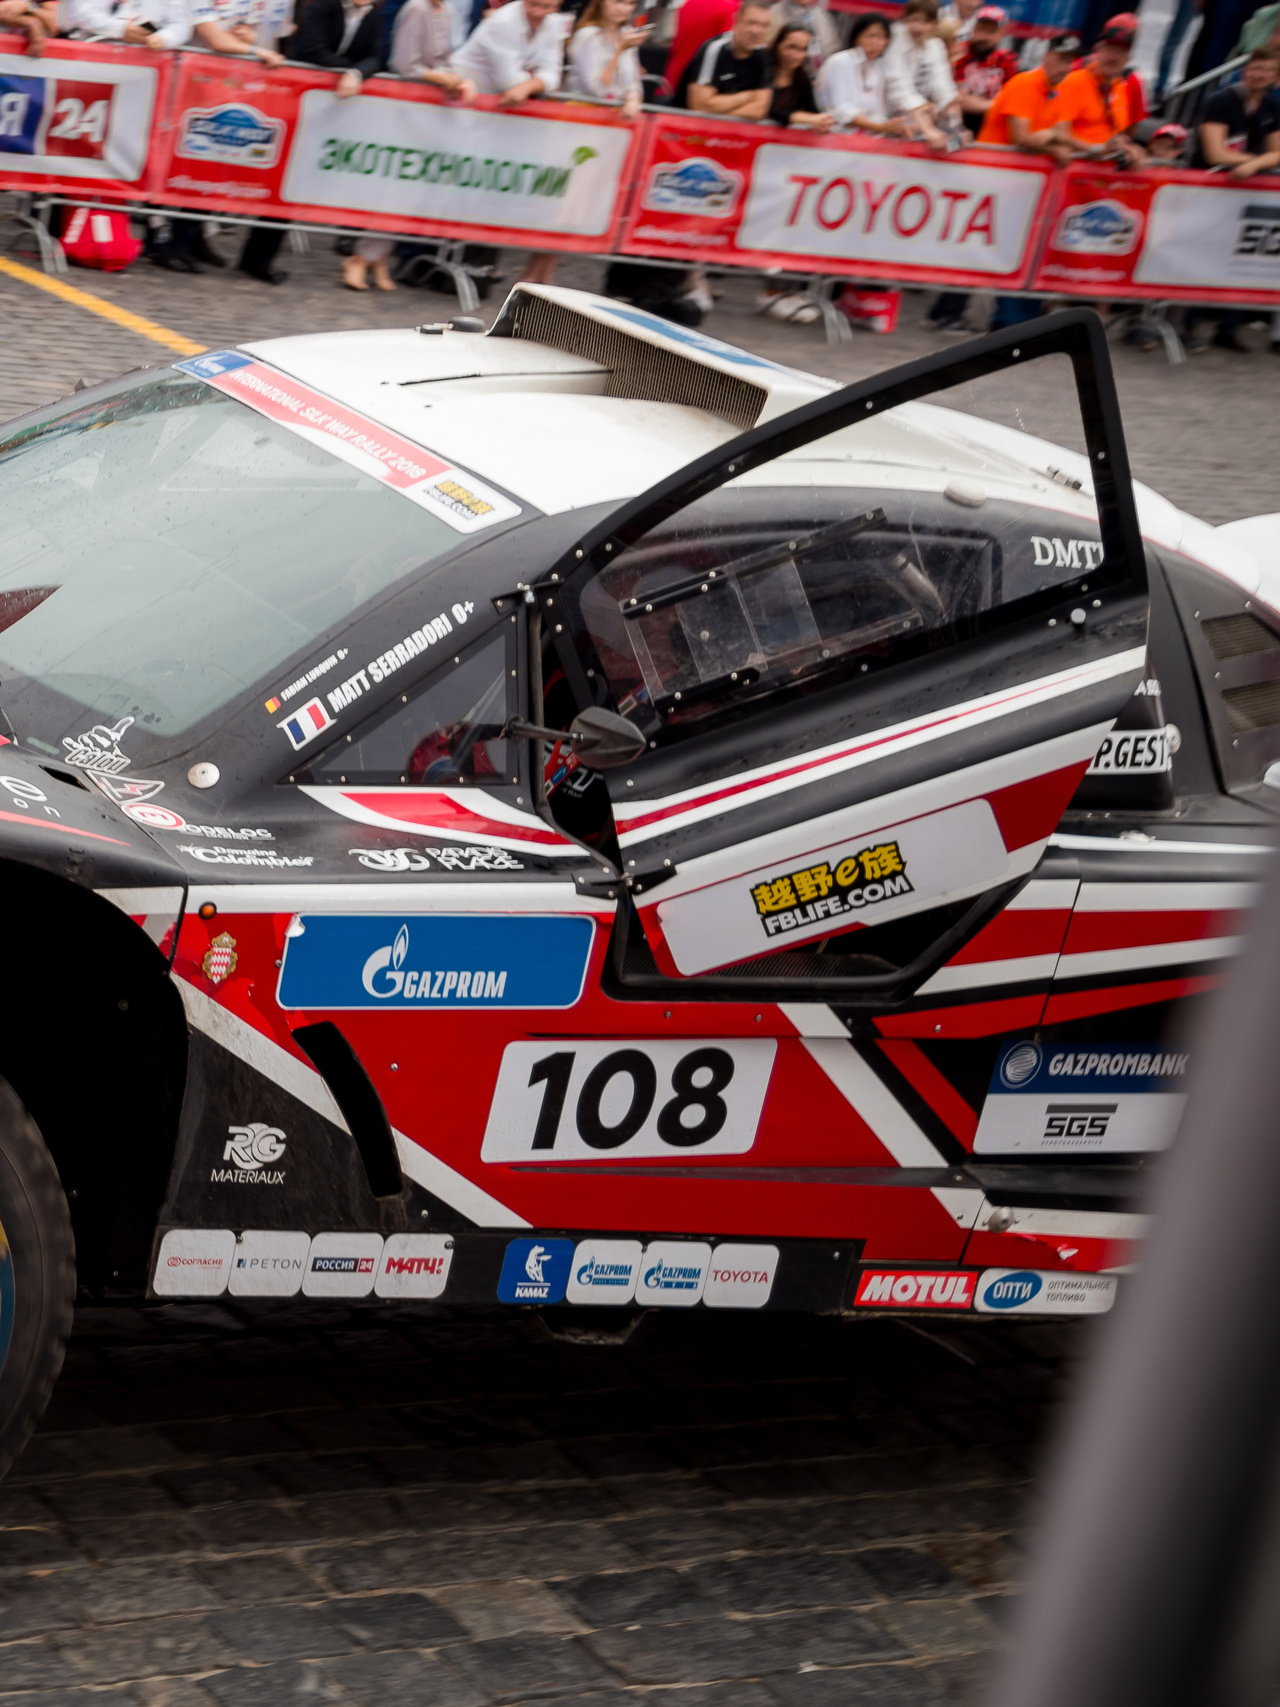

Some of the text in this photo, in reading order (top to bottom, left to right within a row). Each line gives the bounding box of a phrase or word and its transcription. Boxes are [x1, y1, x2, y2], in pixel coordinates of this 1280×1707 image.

[48, 96, 110, 143] 24
[319, 138, 574, 198] ЭКОТЕХНОЛОГИИ
[784, 174, 999, 246] TOYOTA
[298, 405, 332, 430] SILK
[323, 417, 358, 444] WAY
[349, 430, 396, 464] RALLY
[325, 668, 373, 714] MATT
[367, 612, 454, 684] SERRADORI
[279, 673, 310, 702] FABIAN
[304, 654, 339, 686] LURQUIN
[763, 873, 910, 935] FBLIFE.COM
[402, 969, 508, 1000] GAZPROM
[1048, 1053, 1191, 1077] GAZPROMBANK
[527, 1046, 736, 1151] 108
[1042, 1115, 1111, 1138] SGS
[210, 1167, 287, 1186] MATERIAUX
[181, 1257, 224, 1267] СОГЛАСИЕ
[249, 1257, 302, 1271] PETON
[315, 1257, 374, 1272] РОССИЯ 24
[384, 1256, 444, 1276] МАТЧ!
[593, 1264, 633, 1277] GAZPROM
[661, 1266, 703, 1281] GAZPROM
[712, 1269, 769, 1284] TOYOTA
[514, 1286, 549, 1299] KAMAZ
[859, 1274, 969, 1304] MOTUL
[992, 1280, 1034, 1300] ОПТИ
[1047, 1280, 1113, 1292] ОПТИМАЛЬНОЕ
[1045, 1292, 1087, 1303] ТОПЛИВО
